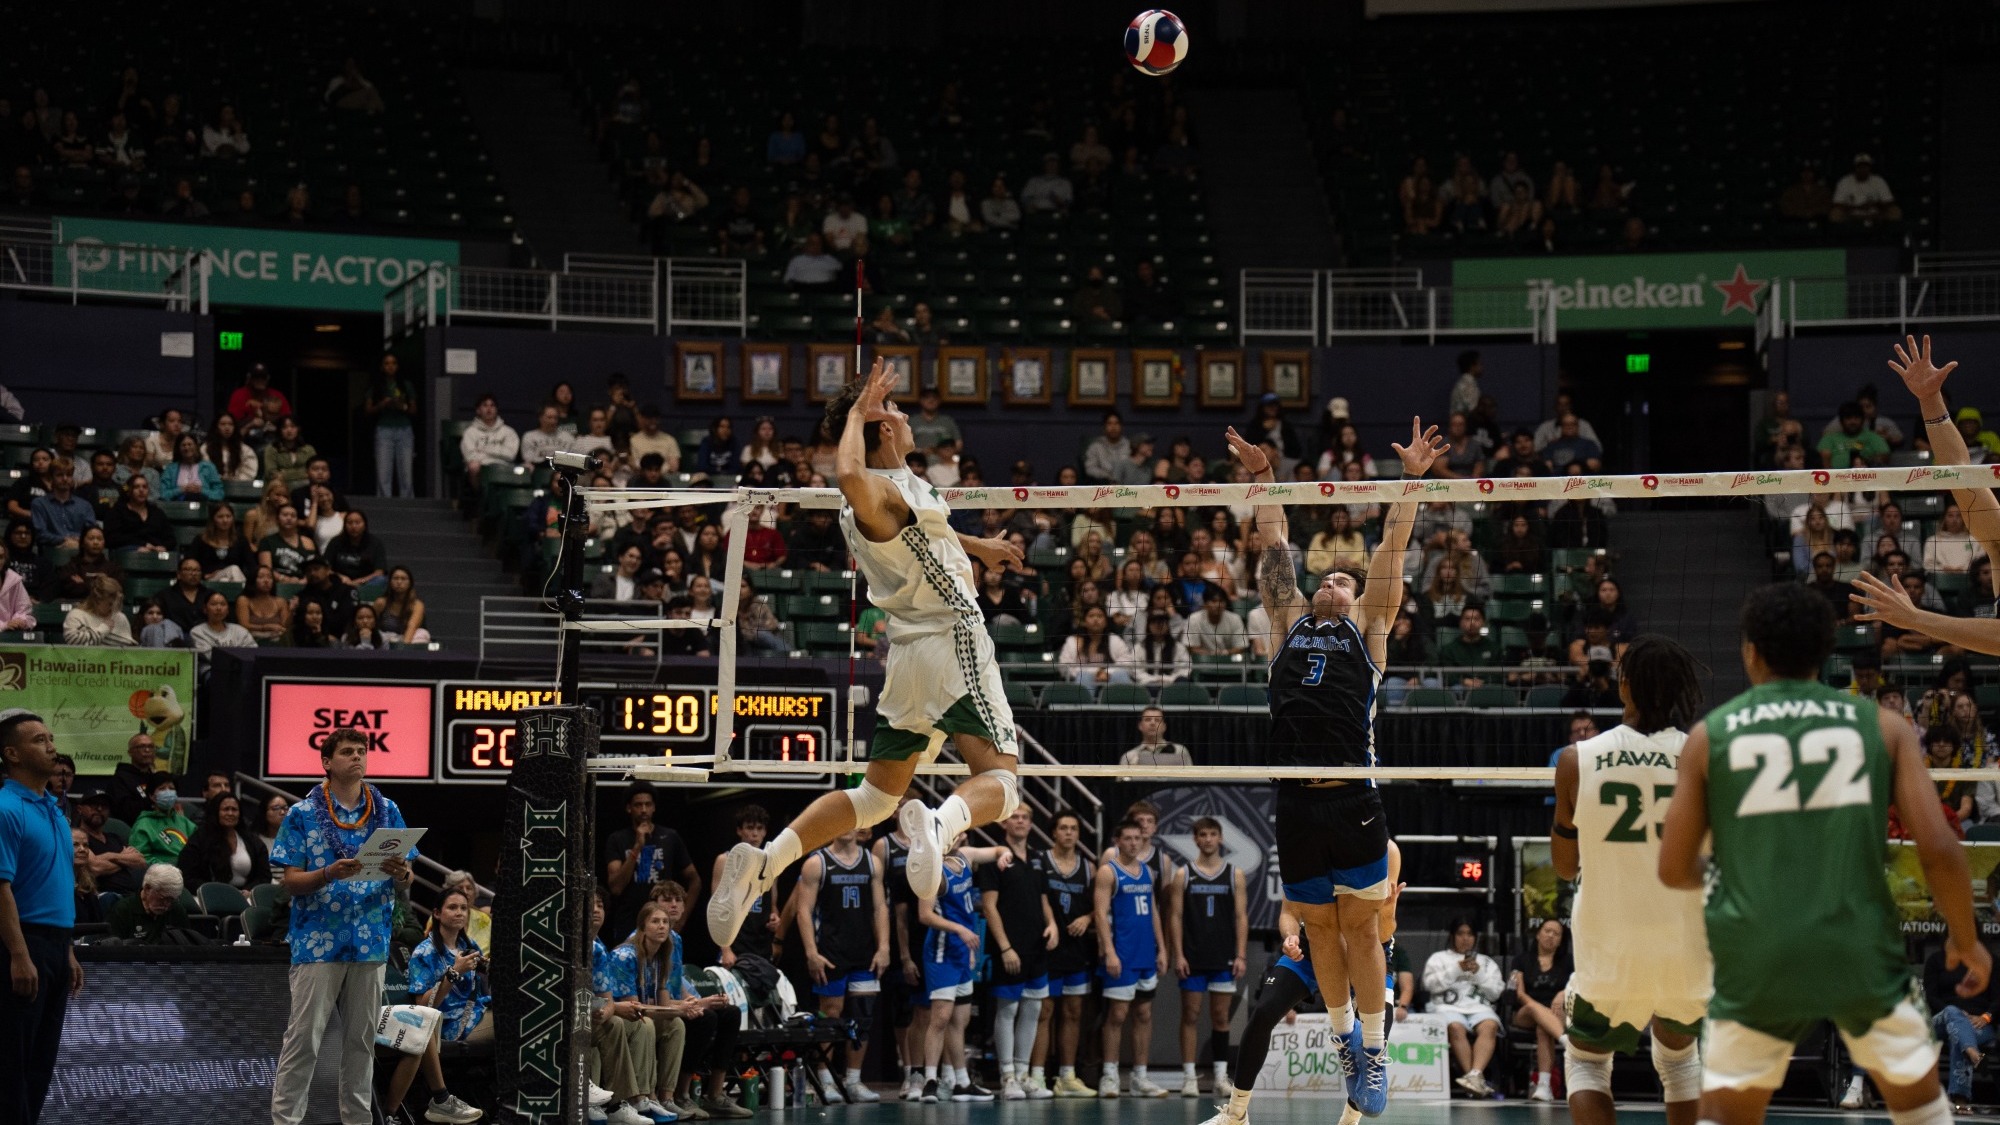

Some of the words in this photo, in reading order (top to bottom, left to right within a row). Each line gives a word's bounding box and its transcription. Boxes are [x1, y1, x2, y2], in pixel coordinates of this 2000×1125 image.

[118, 241, 279, 281] FINNCE
[292, 254, 447, 291] FACTORS
[1525, 276, 1704, 310] Heineken
[220, 331, 243, 350] EXIT
[1756, 475, 1783, 485] Bakery
[1852, 472, 1877, 480] HAWAII
[1932, 469, 1961, 480] Bakery
[1115, 489, 1138, 499] Bakery
[1268, 487, 1292, 497] Bakery
[1425, 483, 1450, 493] Bakery
[1588, 479, 1613, 490] Bakery
[965, 490, 988, 500] Bakery
[30, 659, 106, 674] Hawaiian
[110, 661, 181, 676] Financial
[1302, 653, 1327, 686] 3
[29, 675, 71, 687] Federal
[75, 675, 109, 688] Credit
[113, 677, 149, 689] Union
[623, 695, 699, 734] 1:30
[710, 694, 824, 717] RCKHURST
[313, 708, 389, 729] SEAT
[308, 731, 391, 752] GK
[1727, 726, 1873, 819] 22
[1134, 895, 1149, 916] 16
[1207, 895, 1215, 917] 1
